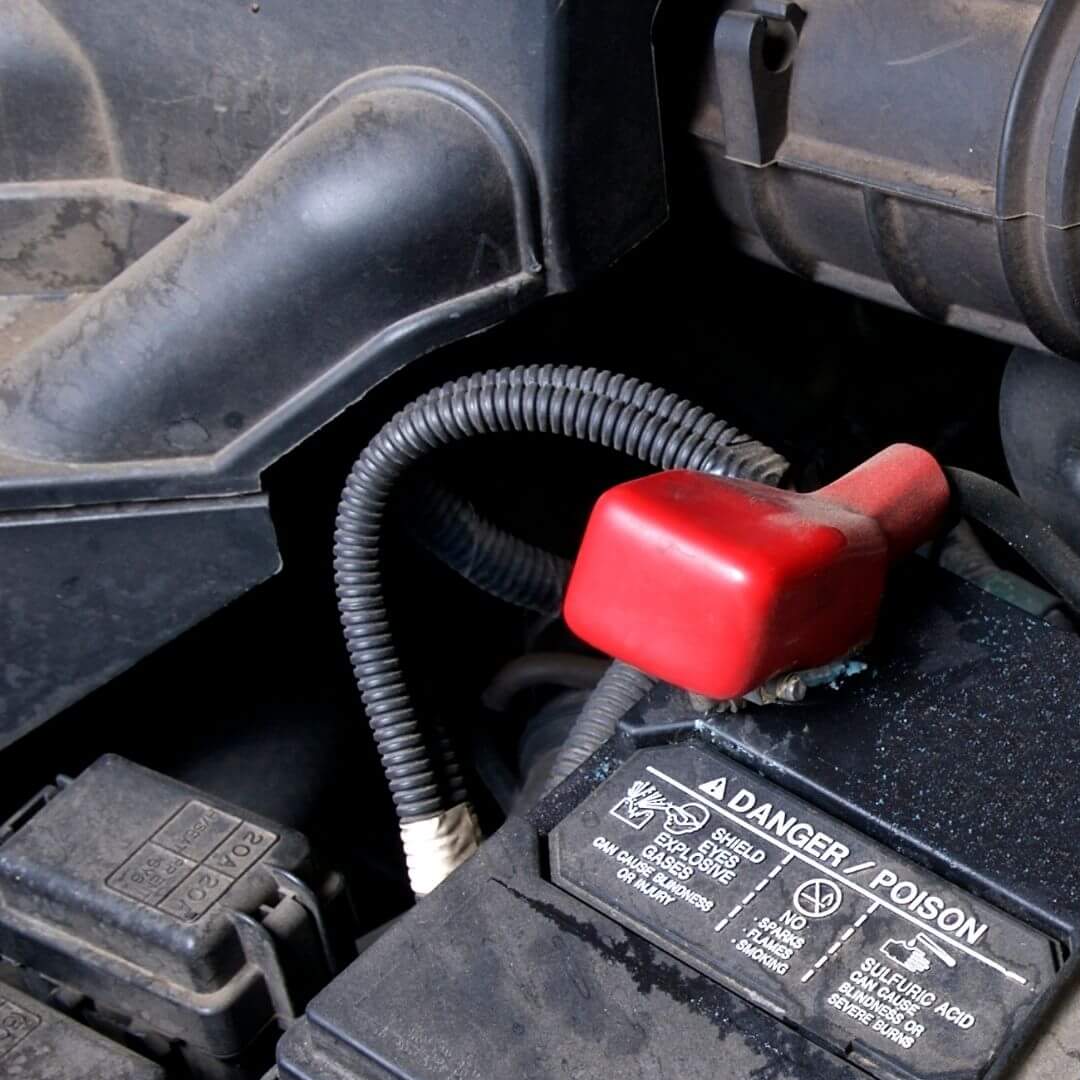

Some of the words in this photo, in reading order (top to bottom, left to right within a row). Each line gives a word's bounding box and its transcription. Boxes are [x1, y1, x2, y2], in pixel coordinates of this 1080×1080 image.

[216, 831, 264, 869] 20A
[641, 845, 694, 881] GASES
[653, 831, 737, 886] EXPLOSIVE
[698, 839, 741, 870] EYES
[711, 827, 766, 864] SHIELD
[592, 836, 620, 856] CAN
[616, 850, 656, 878] CAUSE
[652, 872, 714, 913] BLINDNESS
[728, 788, 850, 868] DANGER
[868, 868, 988, 945] POISON
[616, 867, 637, 884] OR
[633, 877, 676, 906] INJURY
[758, 917, 806, 949] SPARKS
[778, 909, 807, 930] NO
[735, 939, 790, 975] SMOKING
[746, 928, 794, 960] FLAMES
[838, 981, 904, 1025] BLINDNESS
[903, 1020, 925, 1037] OR
[850, 970, 878, 992] CAN
[877, 986, 921, 1016] CAUSE
[861, 957, 936, 1007] SULFURIC
[934, 1001, 975, 1029] ACID
[828, 993, 875, 1026] SEVERE
[872, 1019, 915, 1049] BURNS
